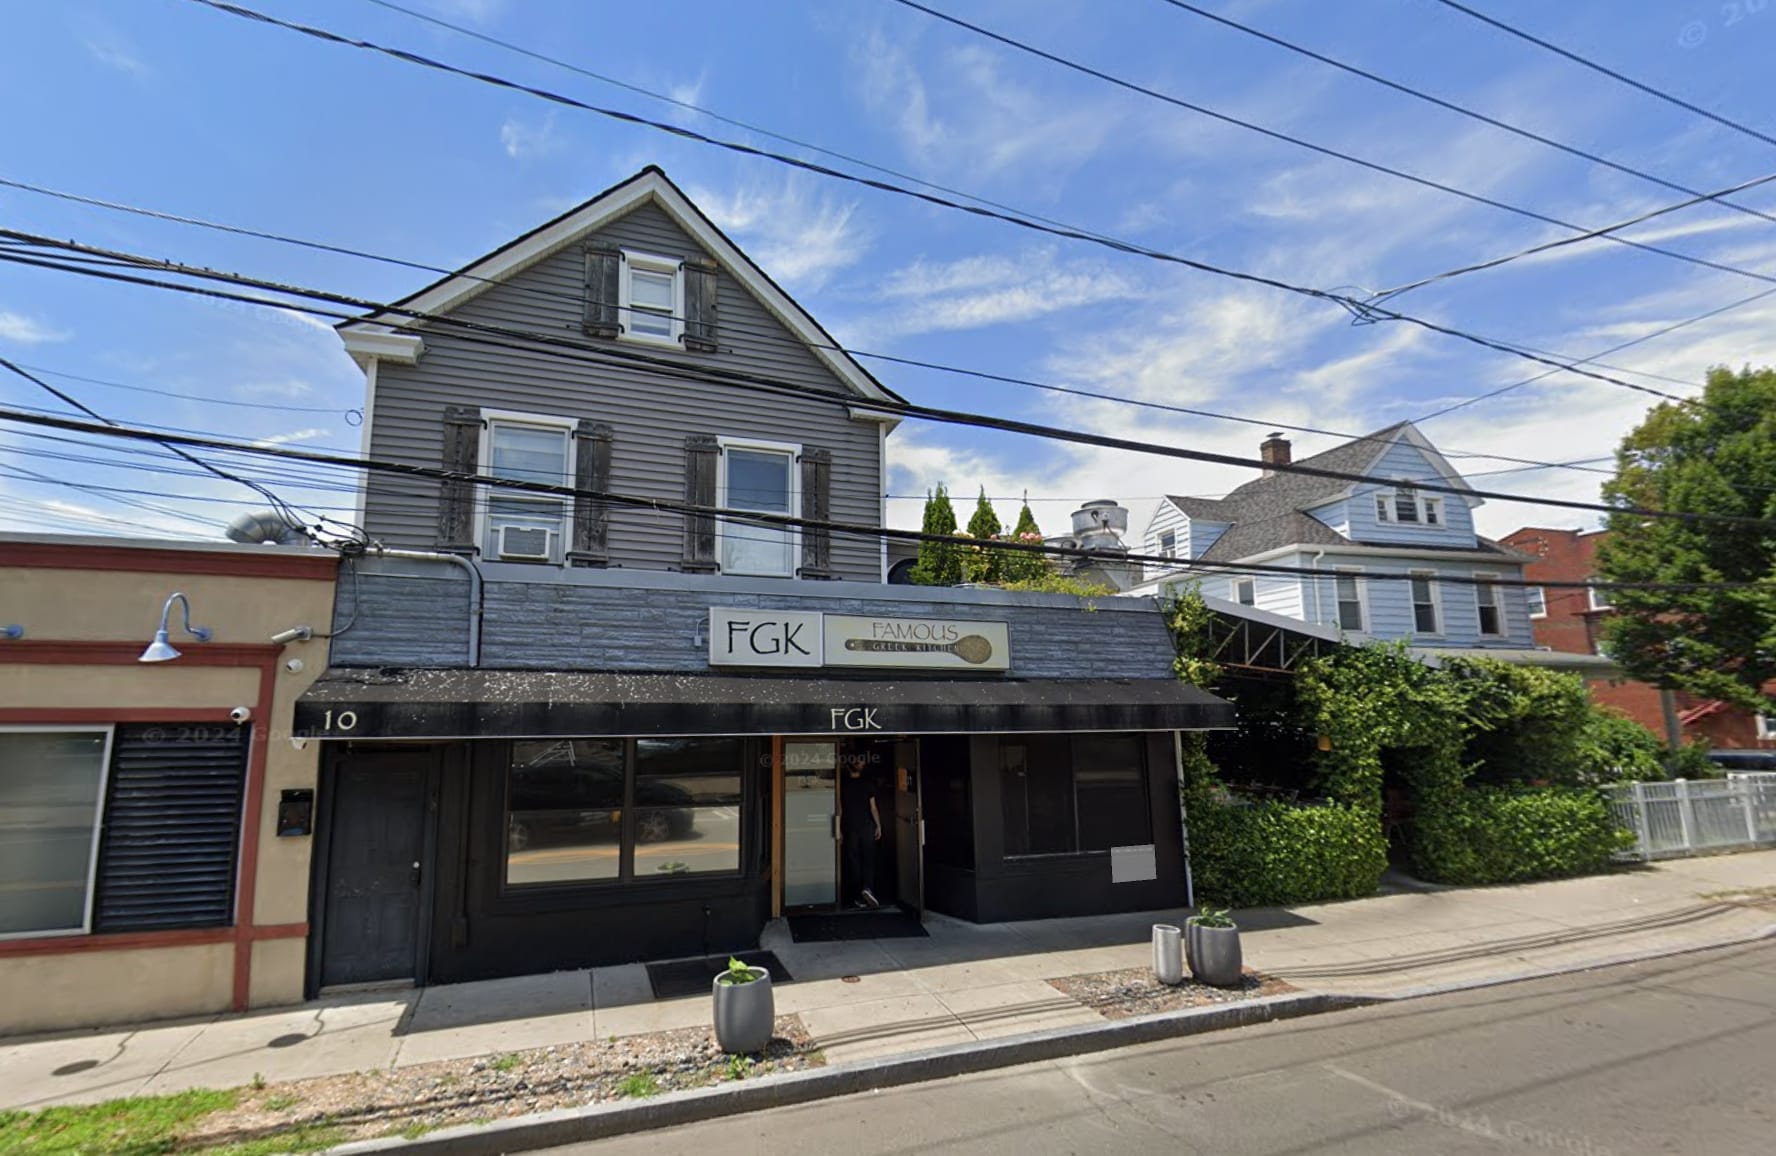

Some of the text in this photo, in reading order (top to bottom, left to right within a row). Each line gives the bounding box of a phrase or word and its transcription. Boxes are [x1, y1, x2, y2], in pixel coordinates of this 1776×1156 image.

[727, 620, 811, 655] FGK
[872, 621, 959, 640] FAMOUS
[324, 710, 357, 730] 10
[830, 708, 882, 730] FGK
